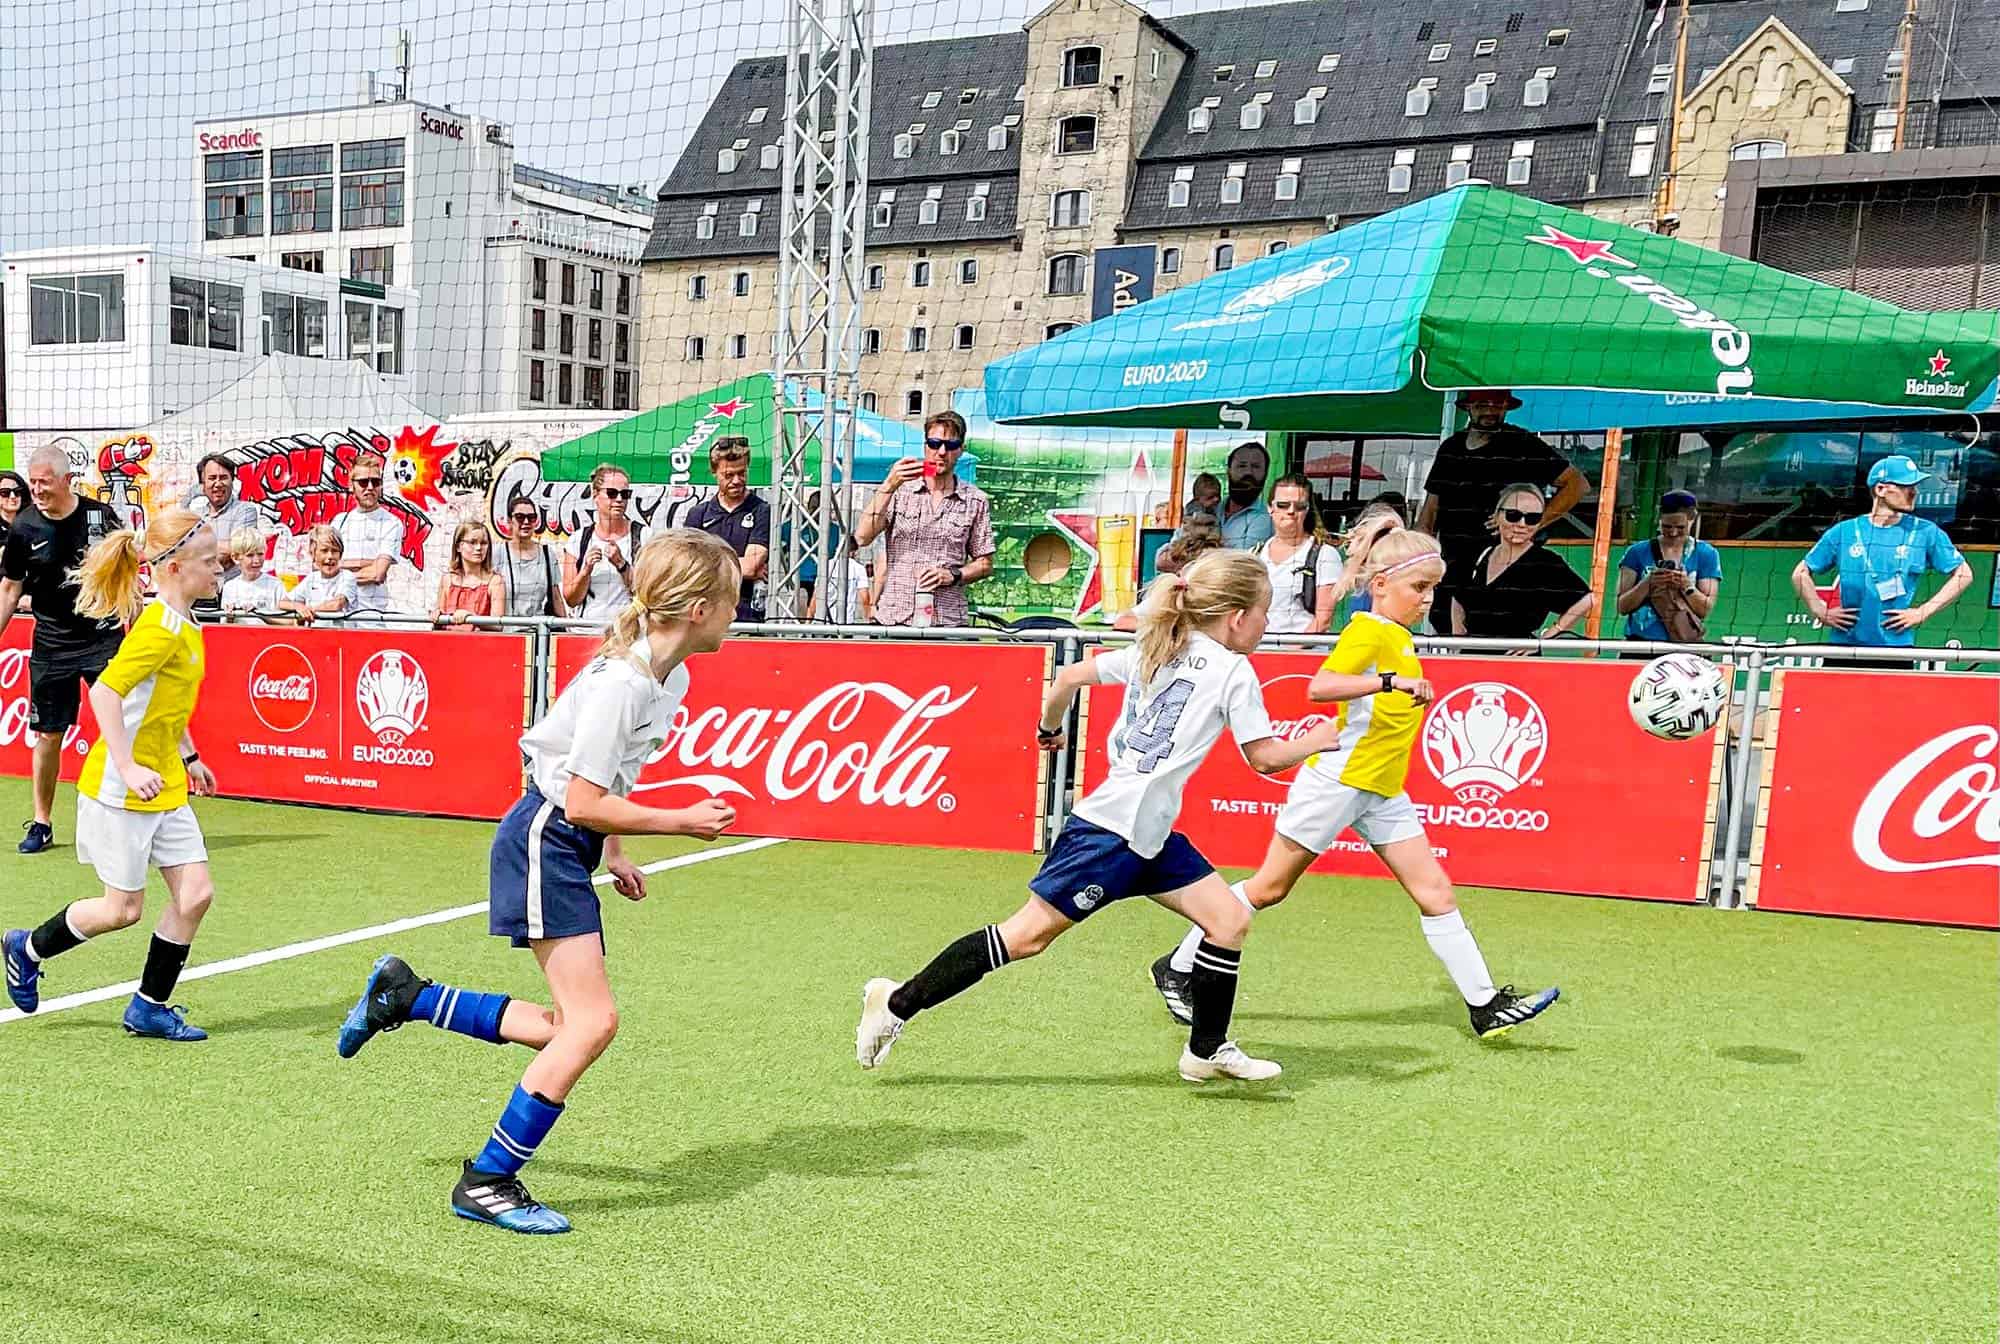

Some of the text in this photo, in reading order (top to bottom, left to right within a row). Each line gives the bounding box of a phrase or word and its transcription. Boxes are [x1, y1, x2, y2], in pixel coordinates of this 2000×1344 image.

[420, 112, 465, 140] Scandic
[200, 128, 262, 150] Scandic
[1122, 359, 1209, 387] EURO 2020
[1904, 378, 1965, 398] Heineken
[236, 446, 326, 503] KOM
[253, 673, 313, 701] Coca-Cola
[239, 743, 267, 755] TASTE
[268, 744, 286, 757] THE
[636, 680, 979, 808] oca-Cola
[304, 774, 378, 789] OFFICIAL PARTNER
[1211, 799, 1259, 814] TASTE
[1455, 787, 1500, 805] UEFA
[1328, 840, 1374, 853] FFICIA
